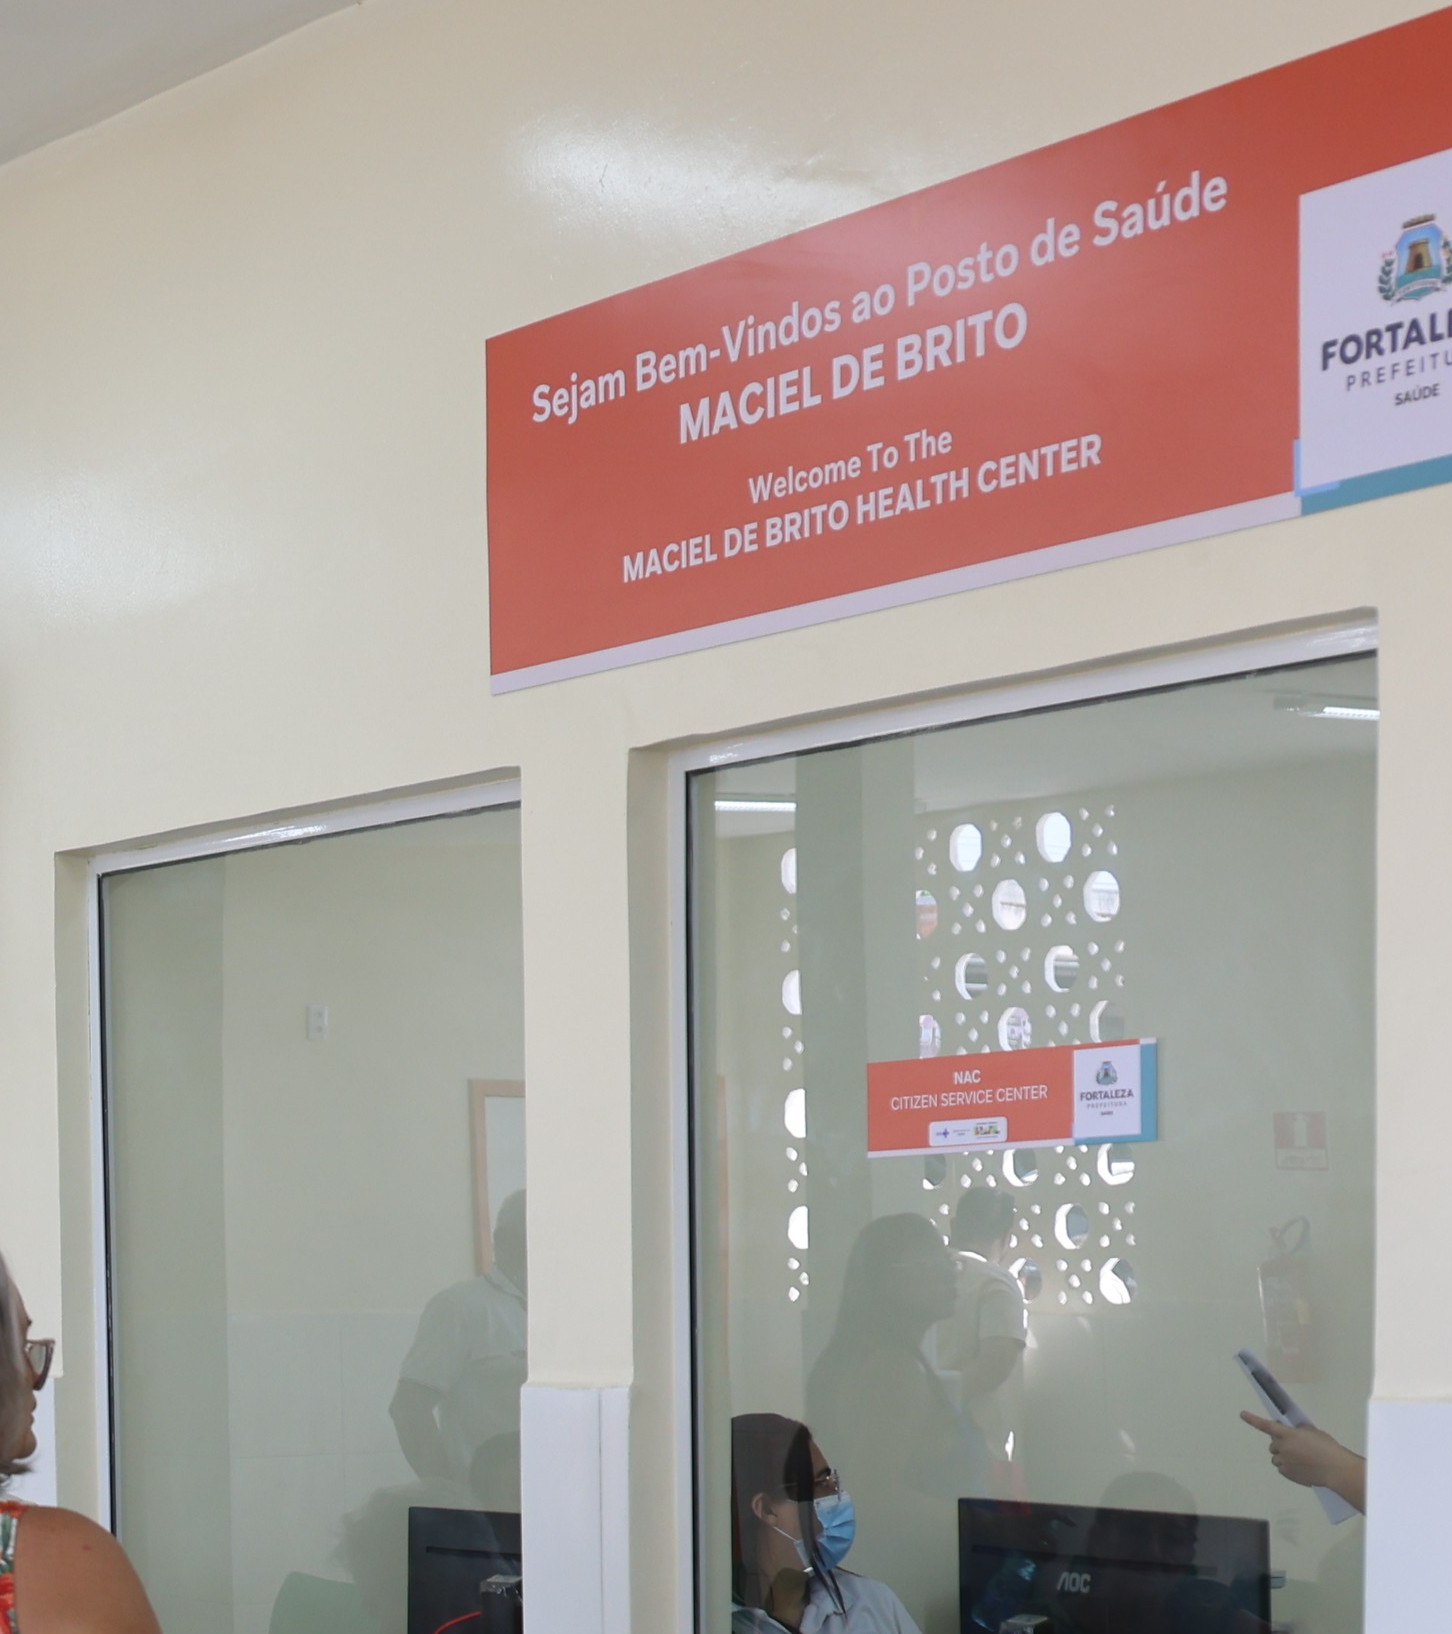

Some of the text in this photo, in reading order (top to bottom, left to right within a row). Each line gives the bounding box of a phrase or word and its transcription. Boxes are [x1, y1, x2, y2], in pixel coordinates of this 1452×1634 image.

[531, 169, 1229, 424] Sejam Bem-Vindos ao Posto de Saúde
[679, 301, 1028, 445] MACIEL DE BRITO
[1394, 382, 1441, 407] SAÚDE
[748, 428, 953, 504] Welcome To The
[622, 433, 1102, 584] MACIEL DE BRITO HEALTH CENTER
[954, 1069, 981, 1085] NAC
[891, 1084, 1049, 1111] CITIZEN SERVICE CENTER
[1080, 1089, 1135, 1102] FORTALEZA
[1056, 1571, 1091, 1593] AOC
